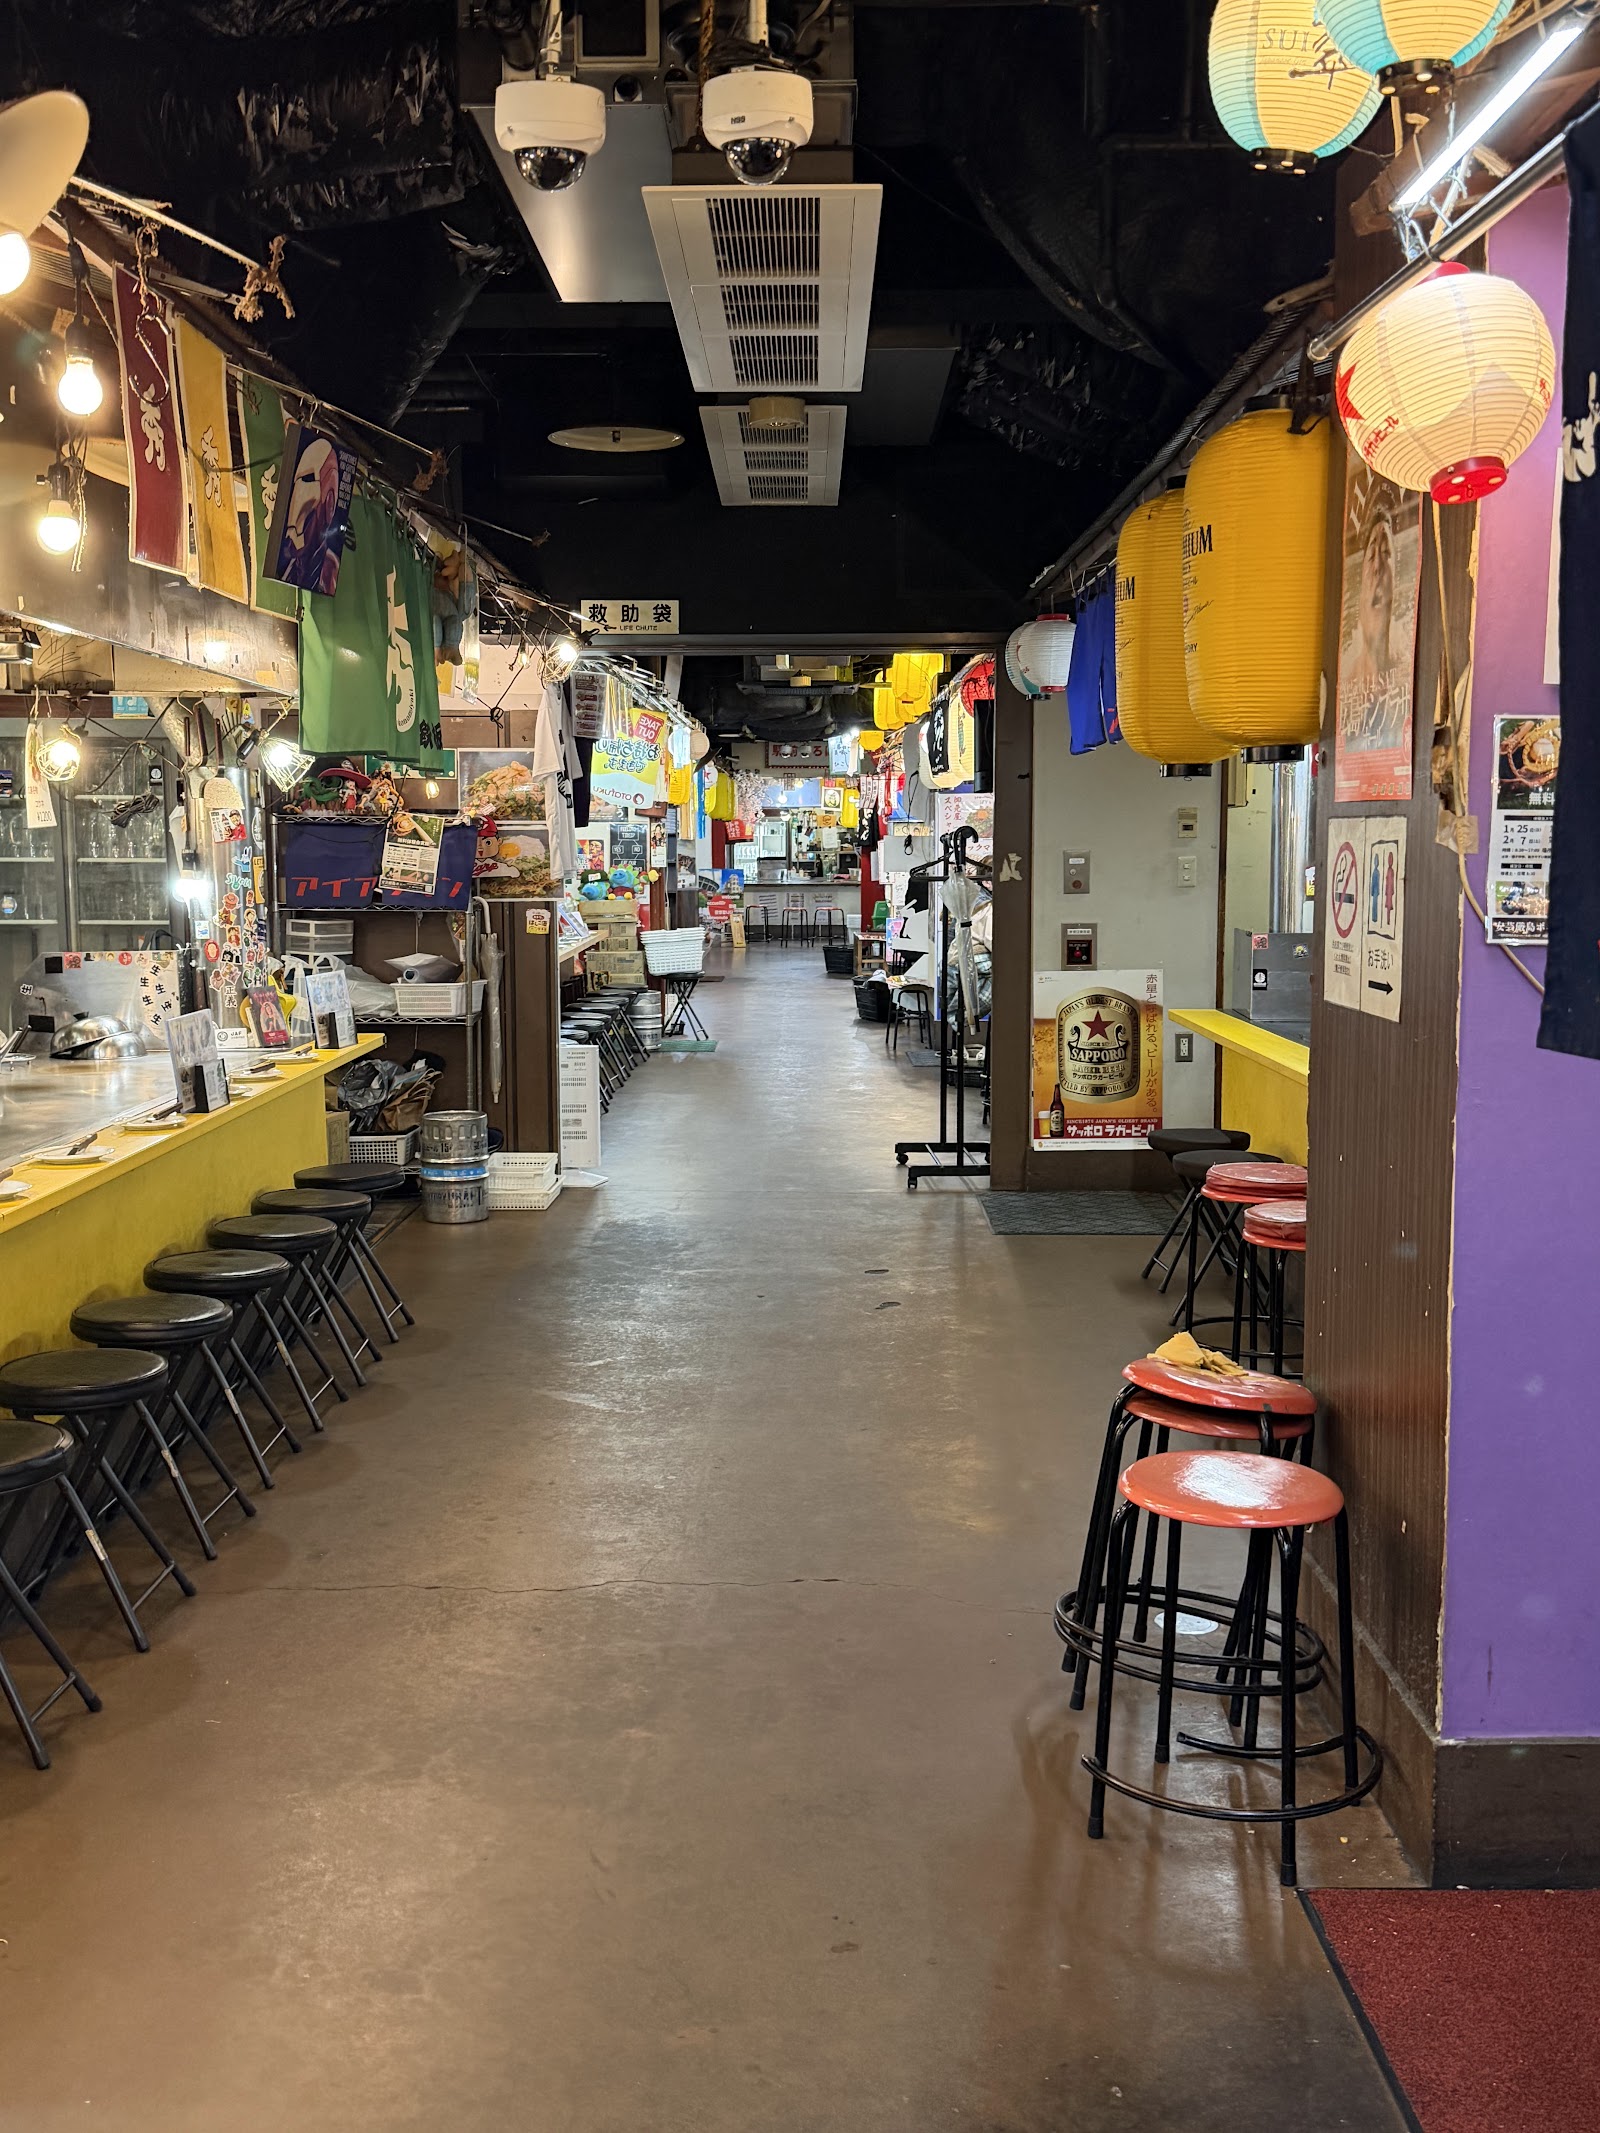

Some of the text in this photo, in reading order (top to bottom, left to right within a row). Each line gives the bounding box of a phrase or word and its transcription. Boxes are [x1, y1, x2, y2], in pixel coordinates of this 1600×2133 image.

[1262, 28, 1310, 52] SUI
[588, 604, 671, 623] 救助袋
[944, 796, 953, 833] スペシャ
[1368, 947, 1394, 971] お手洗い
[151, 965, 161, 976] 生
[140, 977, 149, 987] 生
[155, 983, 166, 994] 生
[142, 995, 153, 1006] 生
[225, 986, 237, 1007] 正義
[161, 1001, 172, 1012] 生
[151, 1013, 162, 1025] 生
[1071, 1047, 1126, 1063] SAPPORO
[1072, 1064, 1126, 1074] LAGER BEER
[1073, 1073, 1125, 1081] サッポロラガービール
[1067, 1124, 1103, 1137] サッポロ
